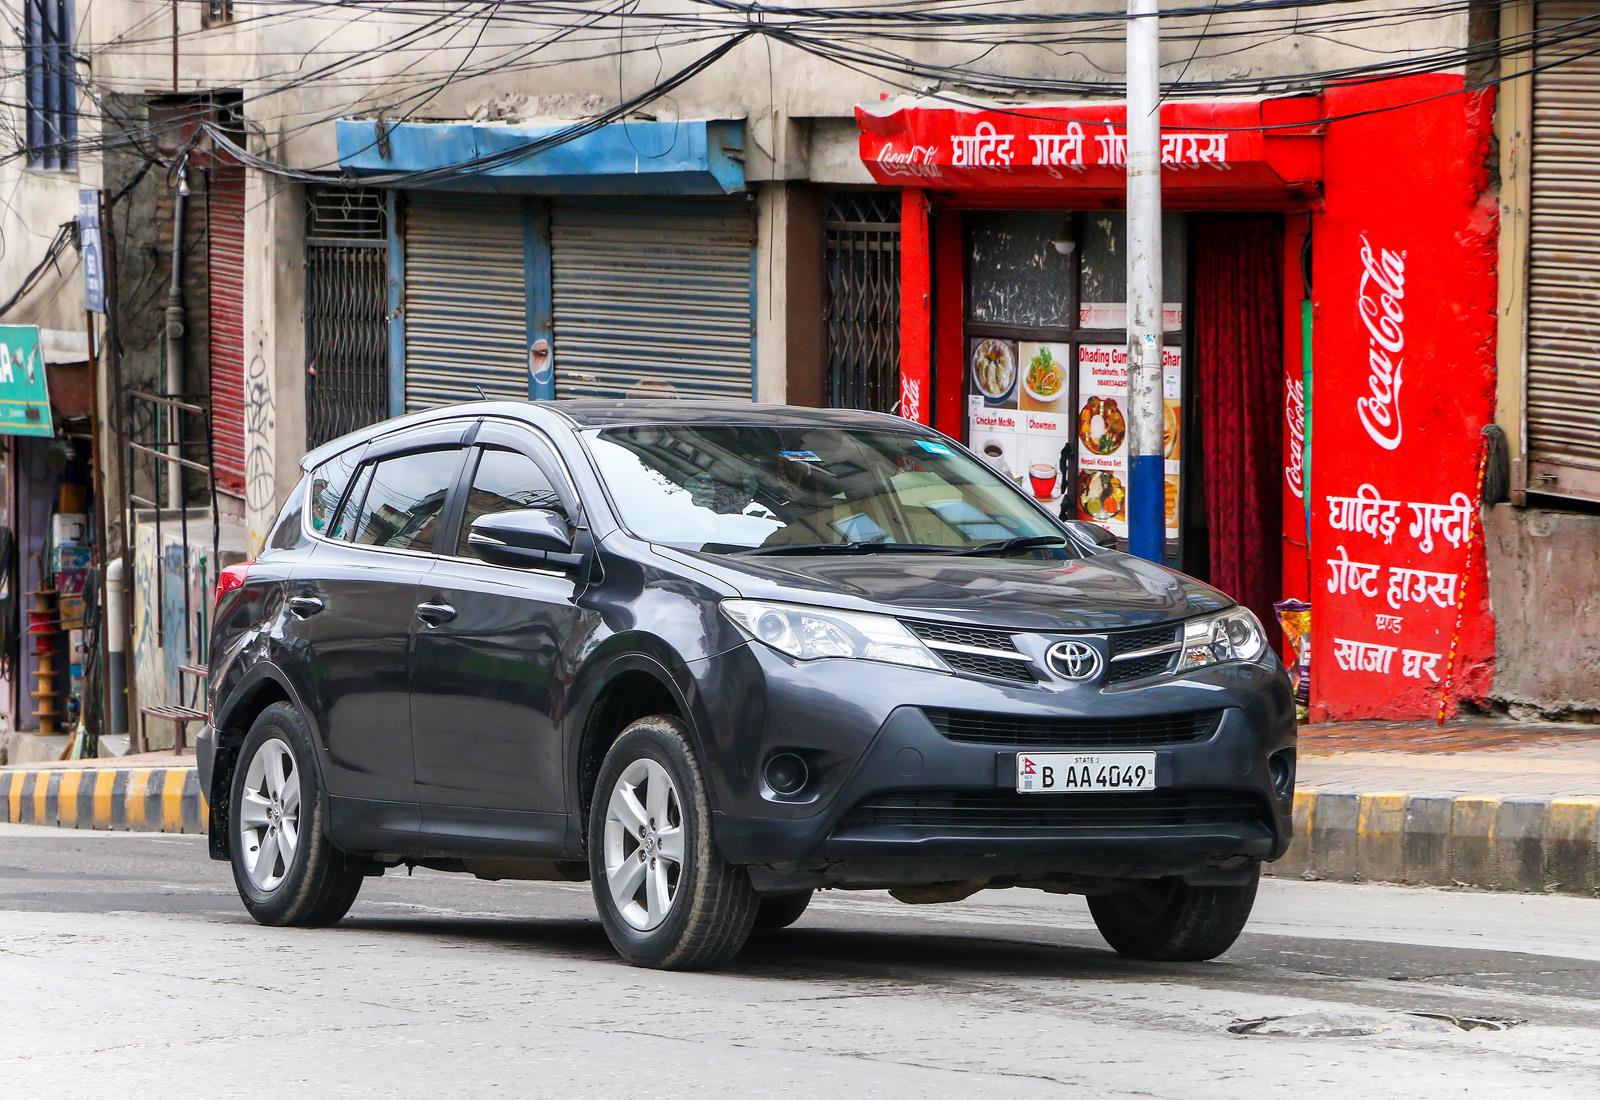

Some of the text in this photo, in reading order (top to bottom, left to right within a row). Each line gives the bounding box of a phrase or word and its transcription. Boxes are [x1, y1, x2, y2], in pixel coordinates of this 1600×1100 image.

[1357, 234, 1406, 450] Coca-Cola
[1080, 347, 1180, 367] Dhading Gum Ghar
[976, 416, 997, 426] Chicken
[1028, 419, 1057, 431] Chowmein
[1080, 457, 1122, 467] Nepali Khana Set
[1387, 567, 1458, 610] हाउस
[1401, 649, 1443, 683] घर
[1042, 766, 1055, 788] B
